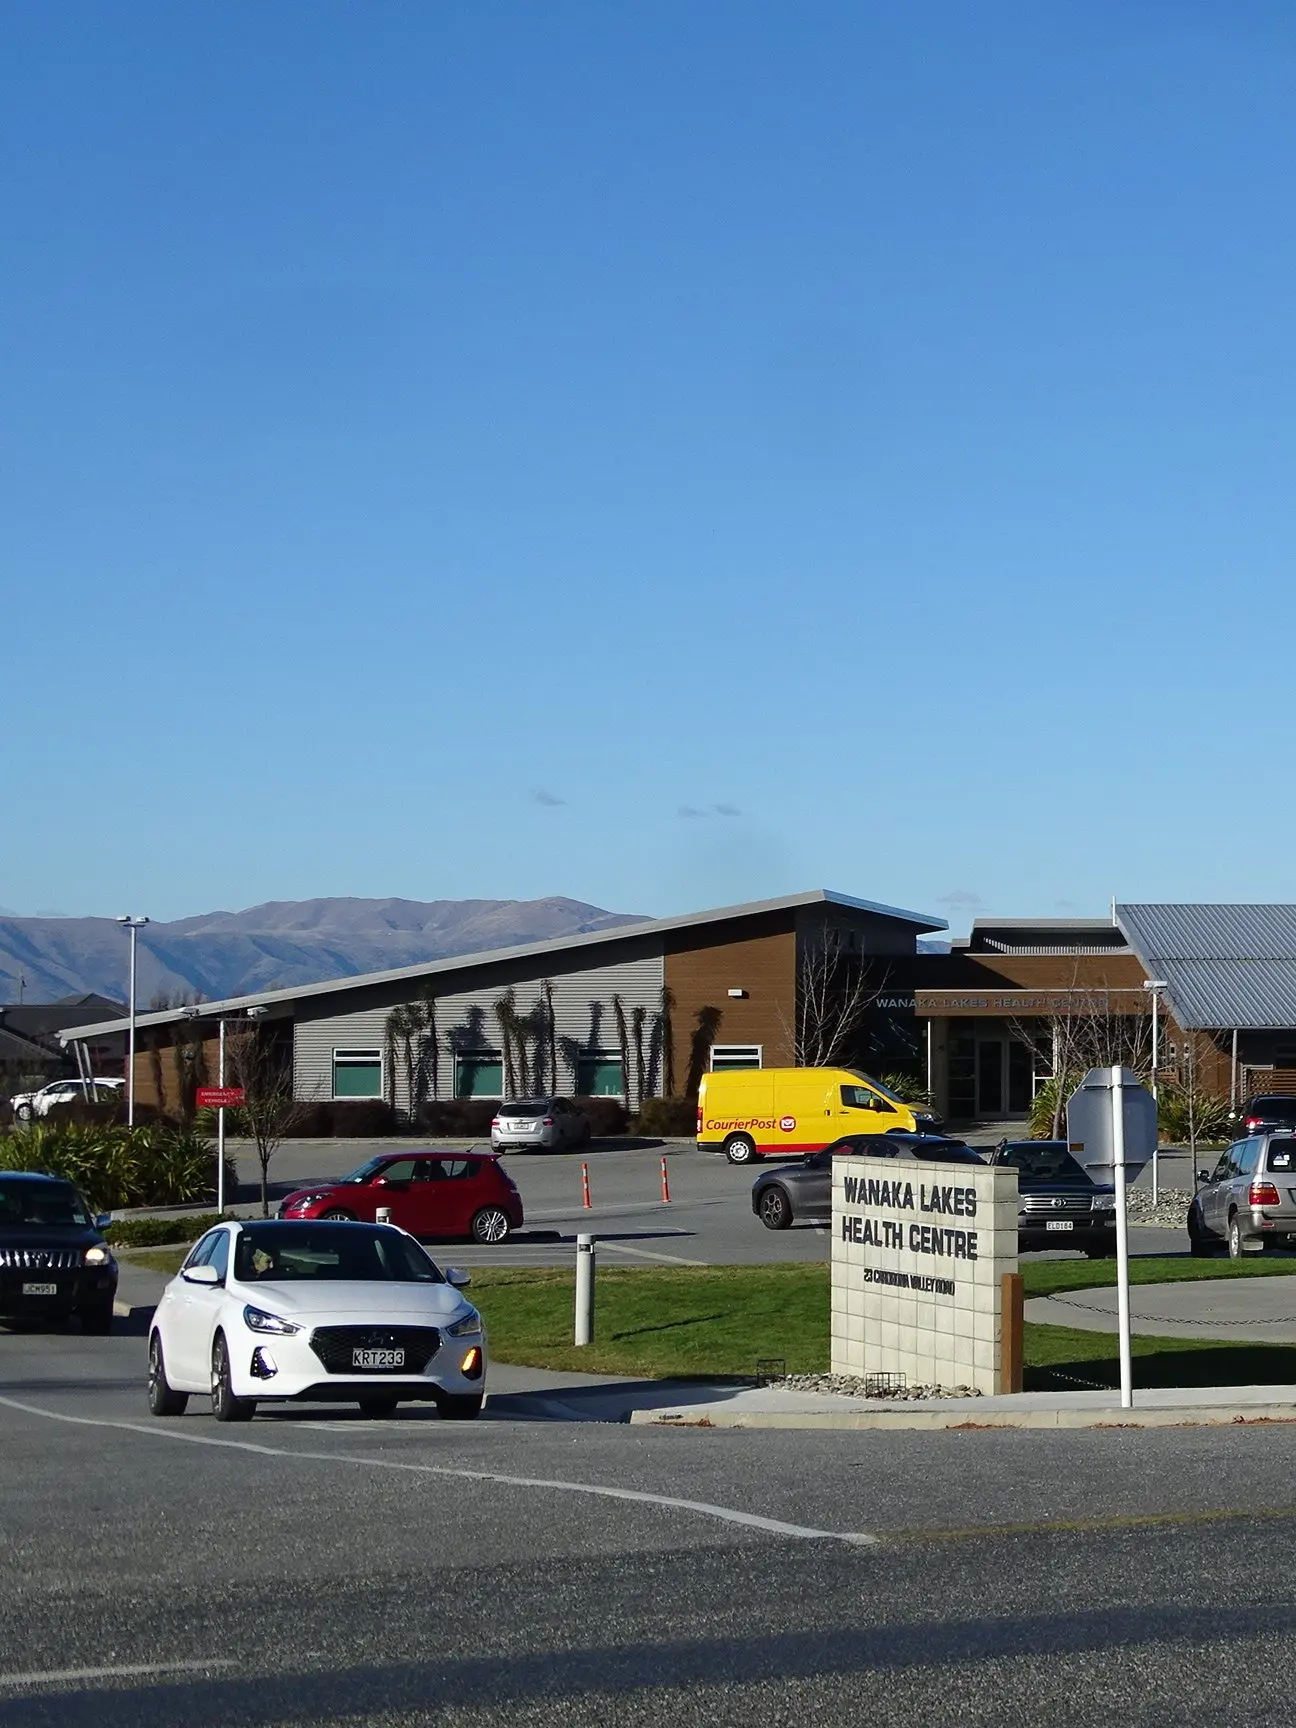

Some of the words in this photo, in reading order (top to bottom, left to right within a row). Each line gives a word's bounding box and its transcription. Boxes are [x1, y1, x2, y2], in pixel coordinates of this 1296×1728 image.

[876, 998, 937, 1008] WANAKA
[943, 998, 988, 1008] LAKES
[993, 998, 1046, 1008] HEALTH
[706, 1119, 776, 1130] CourierPost
[843, 1176, 915, 1210] WANAKA
[920, 1184, 977, 1217] LAKES
[842, 1215, 903, 1250] HEALTH
[909, 1223, 978, 1261] CENTRE
[863, 1268, 873, 1283] 23
[353, 1351, 404, 1365] KRT233
